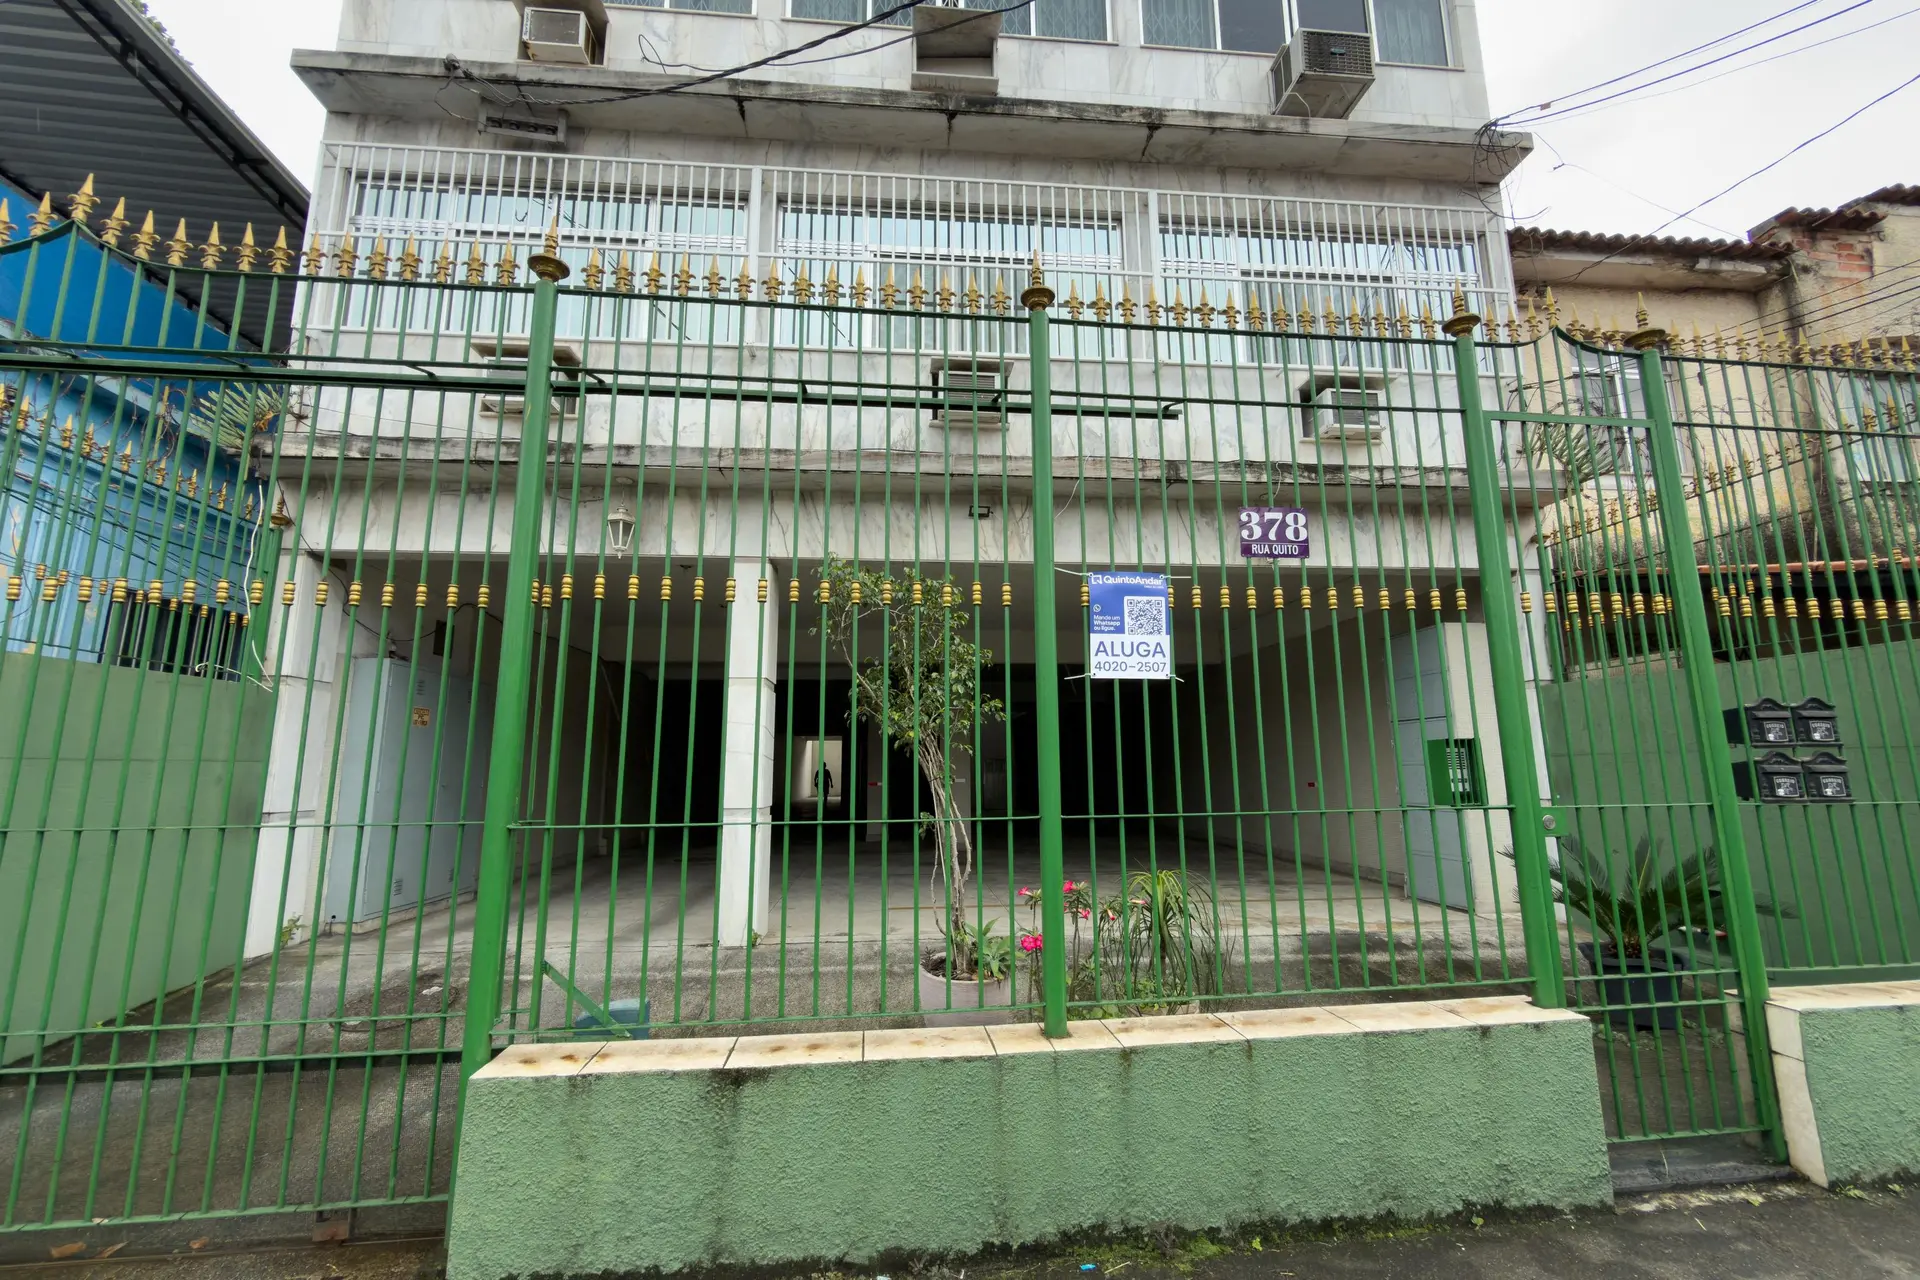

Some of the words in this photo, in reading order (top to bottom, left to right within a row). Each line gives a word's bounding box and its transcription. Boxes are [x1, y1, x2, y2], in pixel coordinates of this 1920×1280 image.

[1240, 511, 1308, 541] 378
[1252, 544, 1270, 554] RUA
[1272, 544, 1299, 555] QUITO
[1104, 576, 1163, 585] QuintoAndar
[1094, 640, 1167, 658] ALUGA
[1094, 661, 1167, 673] 4020-2507
